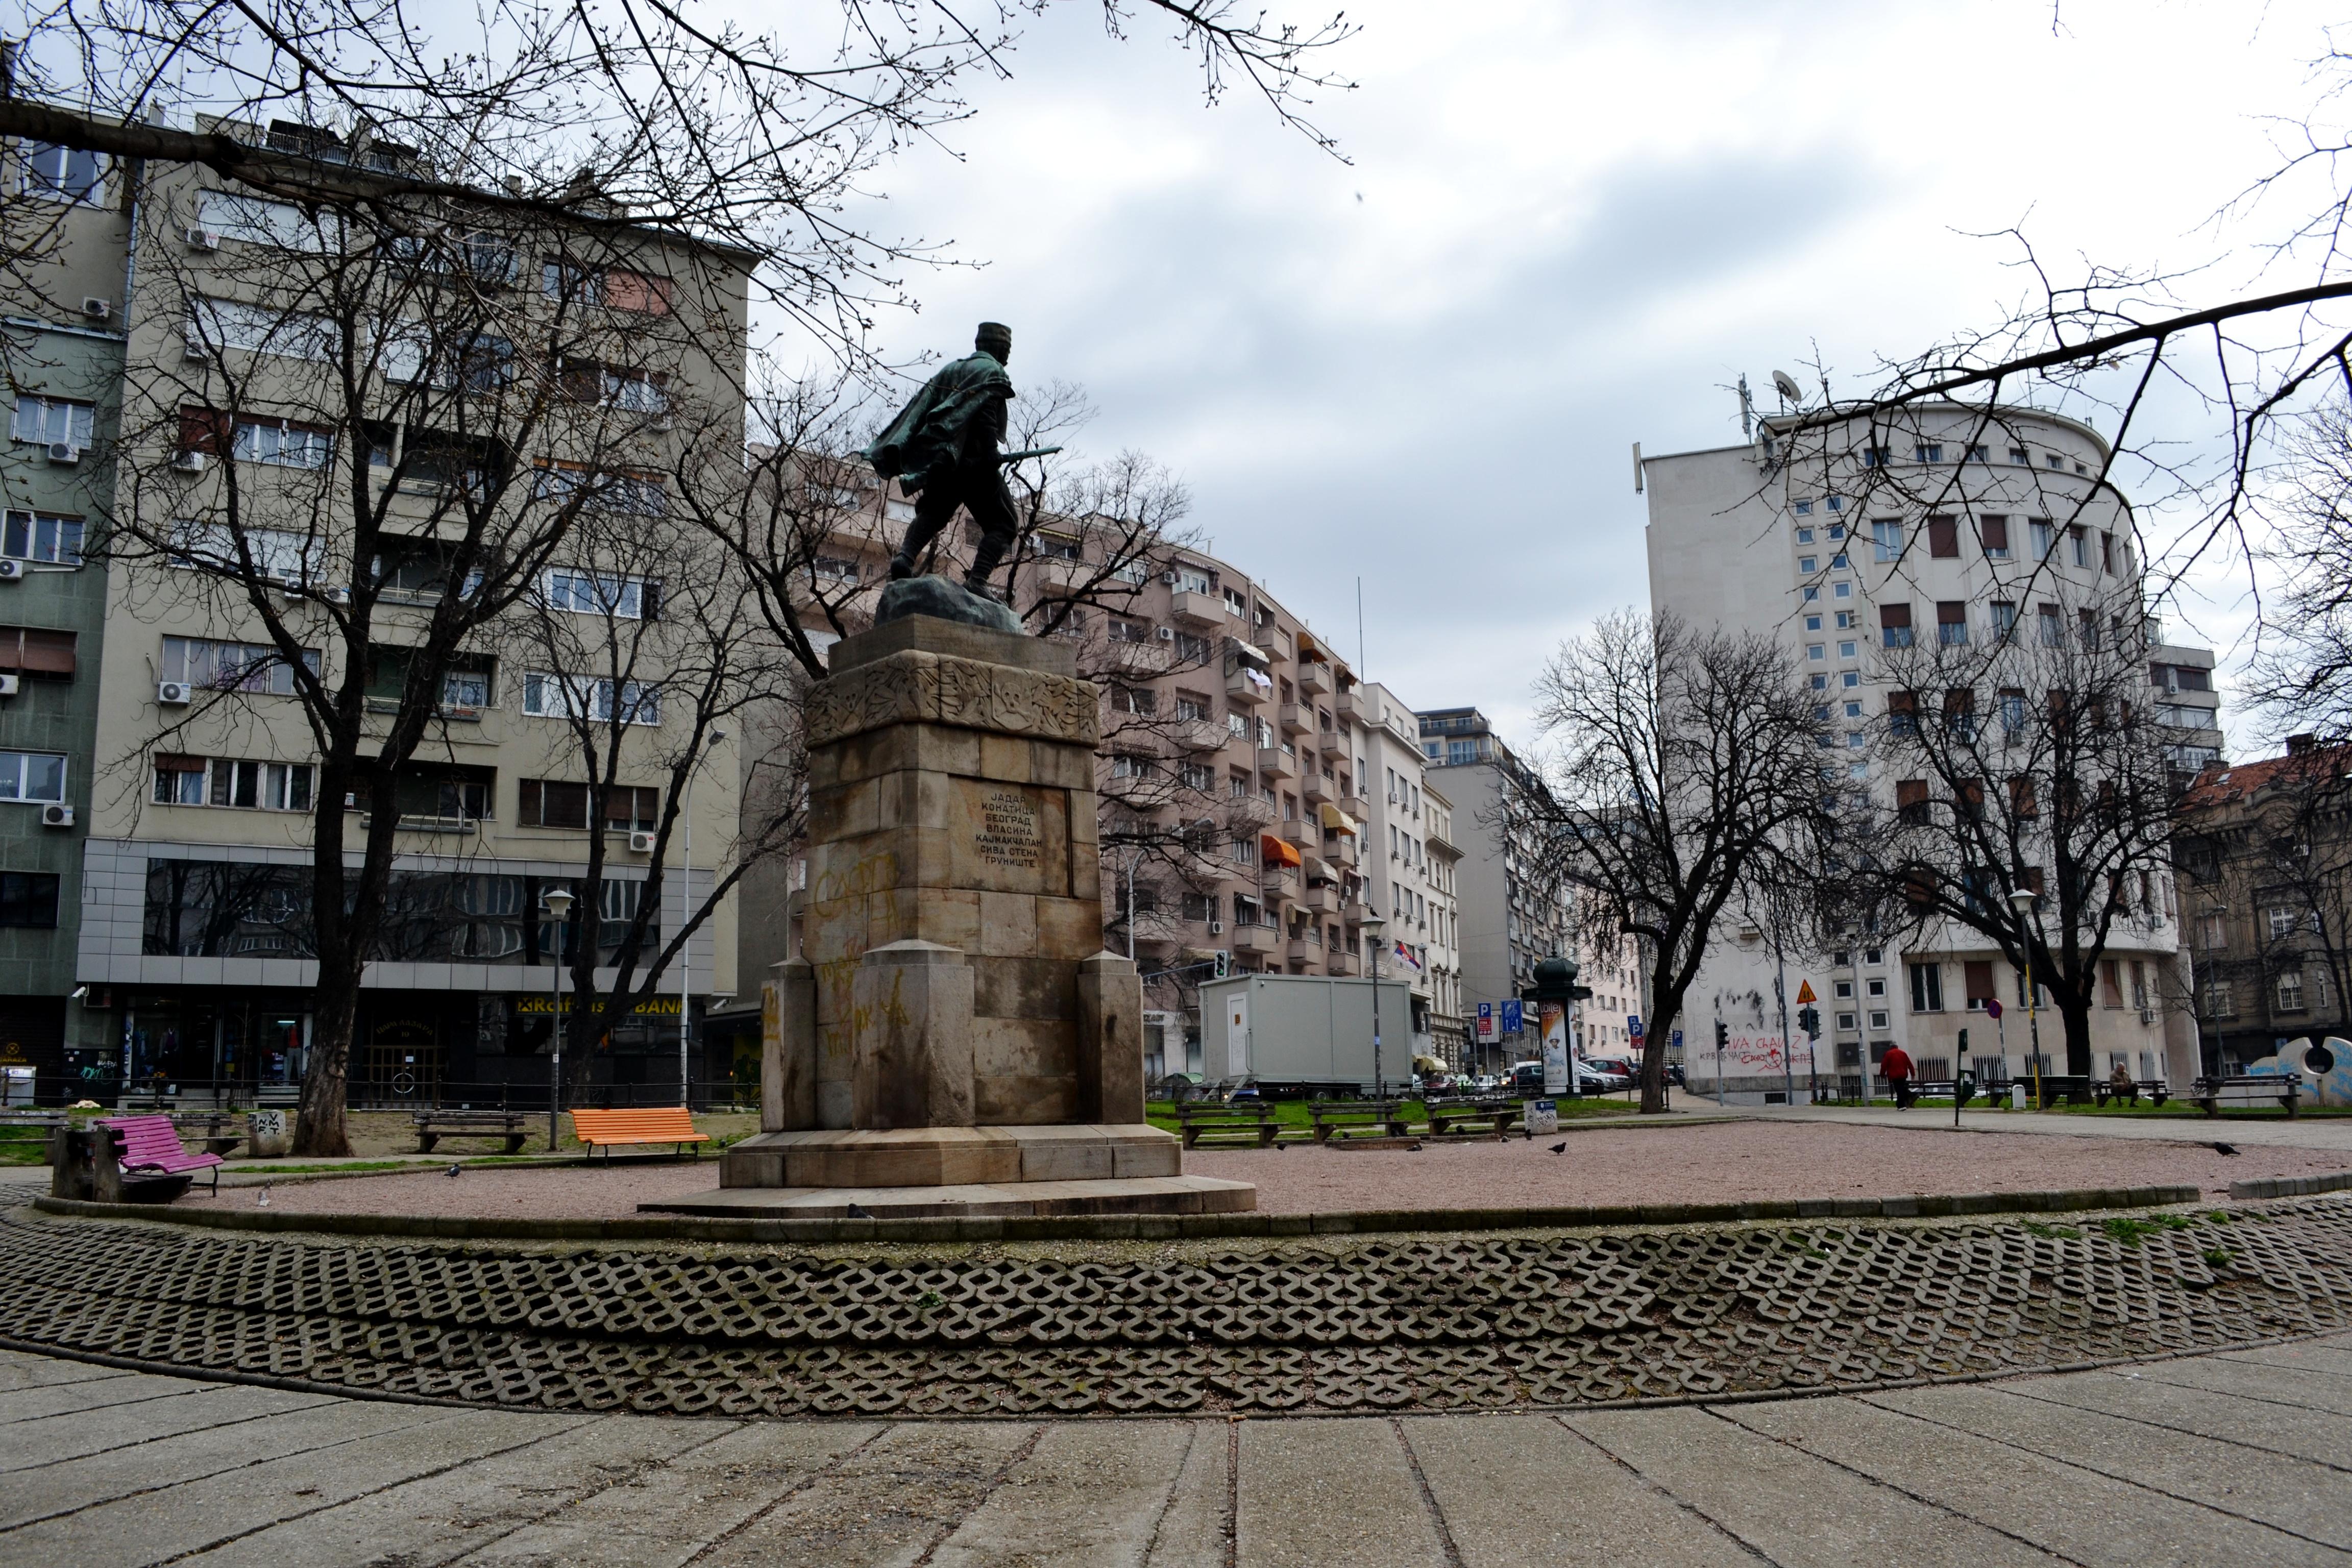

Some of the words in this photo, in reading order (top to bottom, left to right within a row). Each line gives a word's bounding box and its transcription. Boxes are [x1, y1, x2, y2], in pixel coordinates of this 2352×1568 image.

[991, 793, 1025, 803] ЈАДАР
[982, 802, 1035, 815] КОНАТИЦА
[986, 814, 1031, 826] БЕОГРАД
[987, 824, 1033, 836] ВЛАСИНА
[975, 834, 1042, 848] КАЈМАКЧАЛАН
[981, 845, 1004, 854] СИВА
[1009, 847, 1038, 857] СТЕНА
[986, 856, 1035, 867] ГРУНИШТЕ
[1481, 1004, 1488, 1016] P
[1633, 1024, 1640, 1035] P
